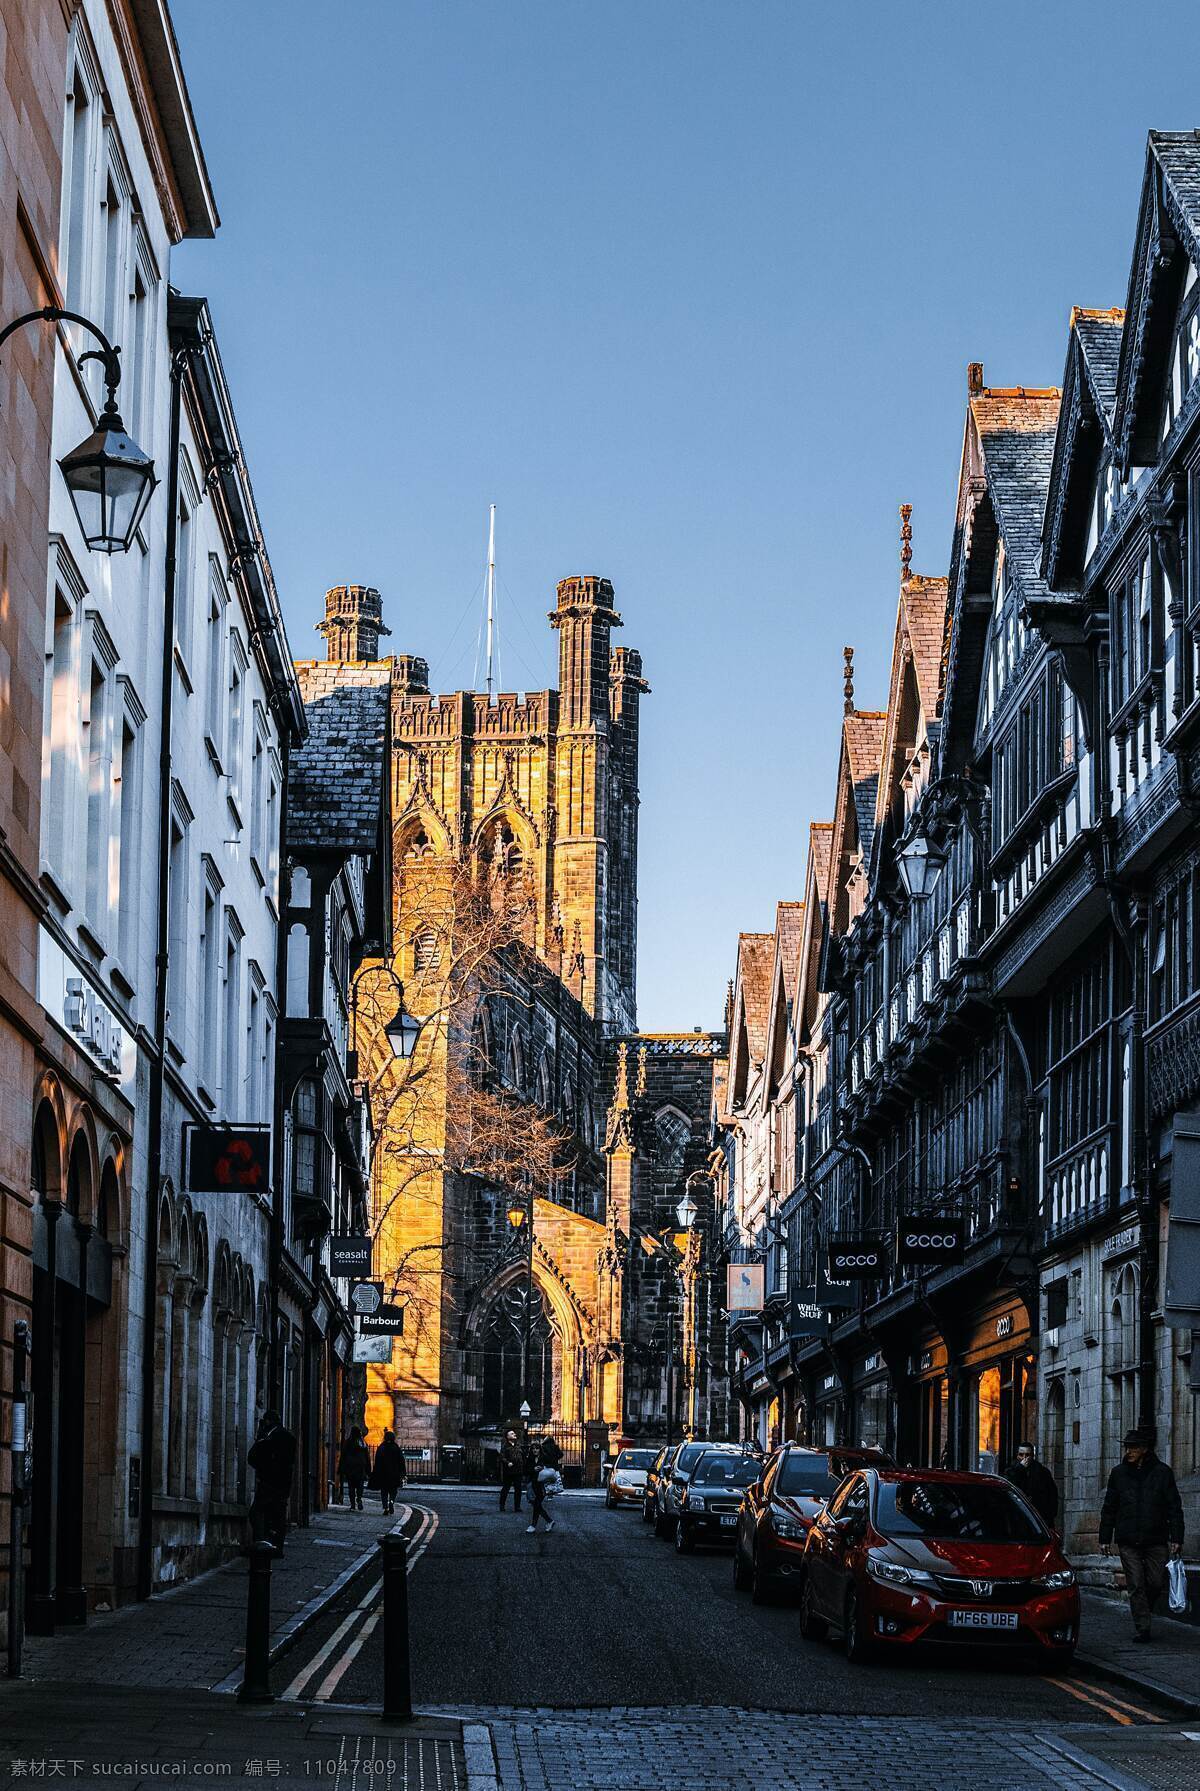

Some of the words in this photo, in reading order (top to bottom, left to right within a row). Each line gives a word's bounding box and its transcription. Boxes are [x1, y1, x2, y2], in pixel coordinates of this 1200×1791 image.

[906, 1234, 956, 1248] ecco
[334, 1249, 368, 1259] seasalt
[835, 1255, 877, 1267] ecco
[363, 1315, 400, 1326] Barbour
[956, 1611, 988, 1625] MF66
[991, 1614, 1015, 1627] UBE
